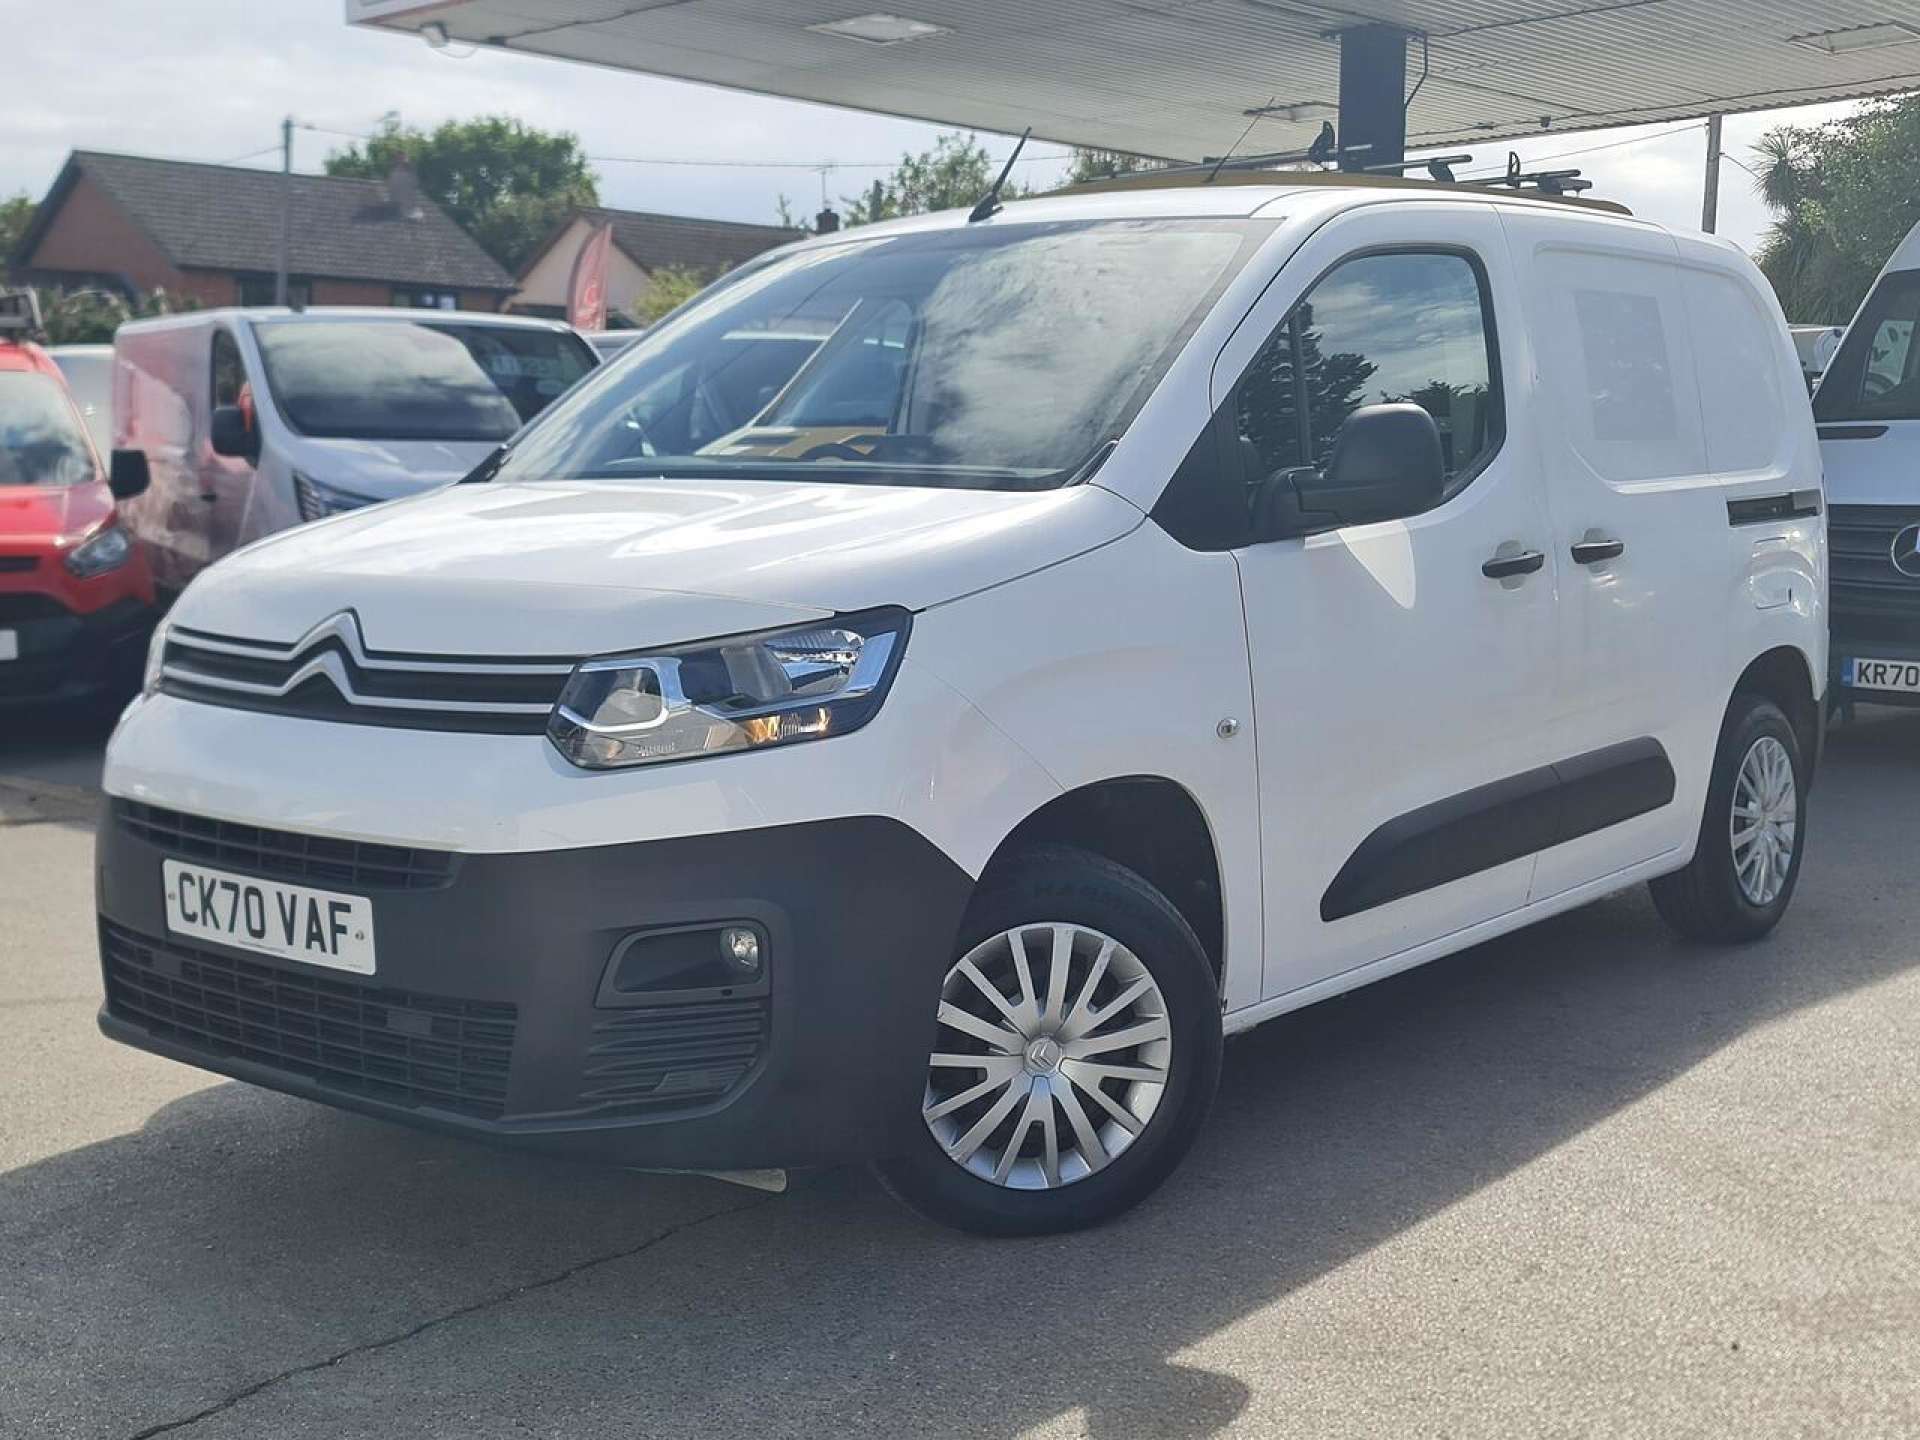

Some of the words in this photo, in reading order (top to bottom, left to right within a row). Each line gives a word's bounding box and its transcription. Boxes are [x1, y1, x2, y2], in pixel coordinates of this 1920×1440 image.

[1857, 662, 1919, 687] KR70
[178, 871, 266, 940] CK70
[276, 890, 352, 955] VAF
